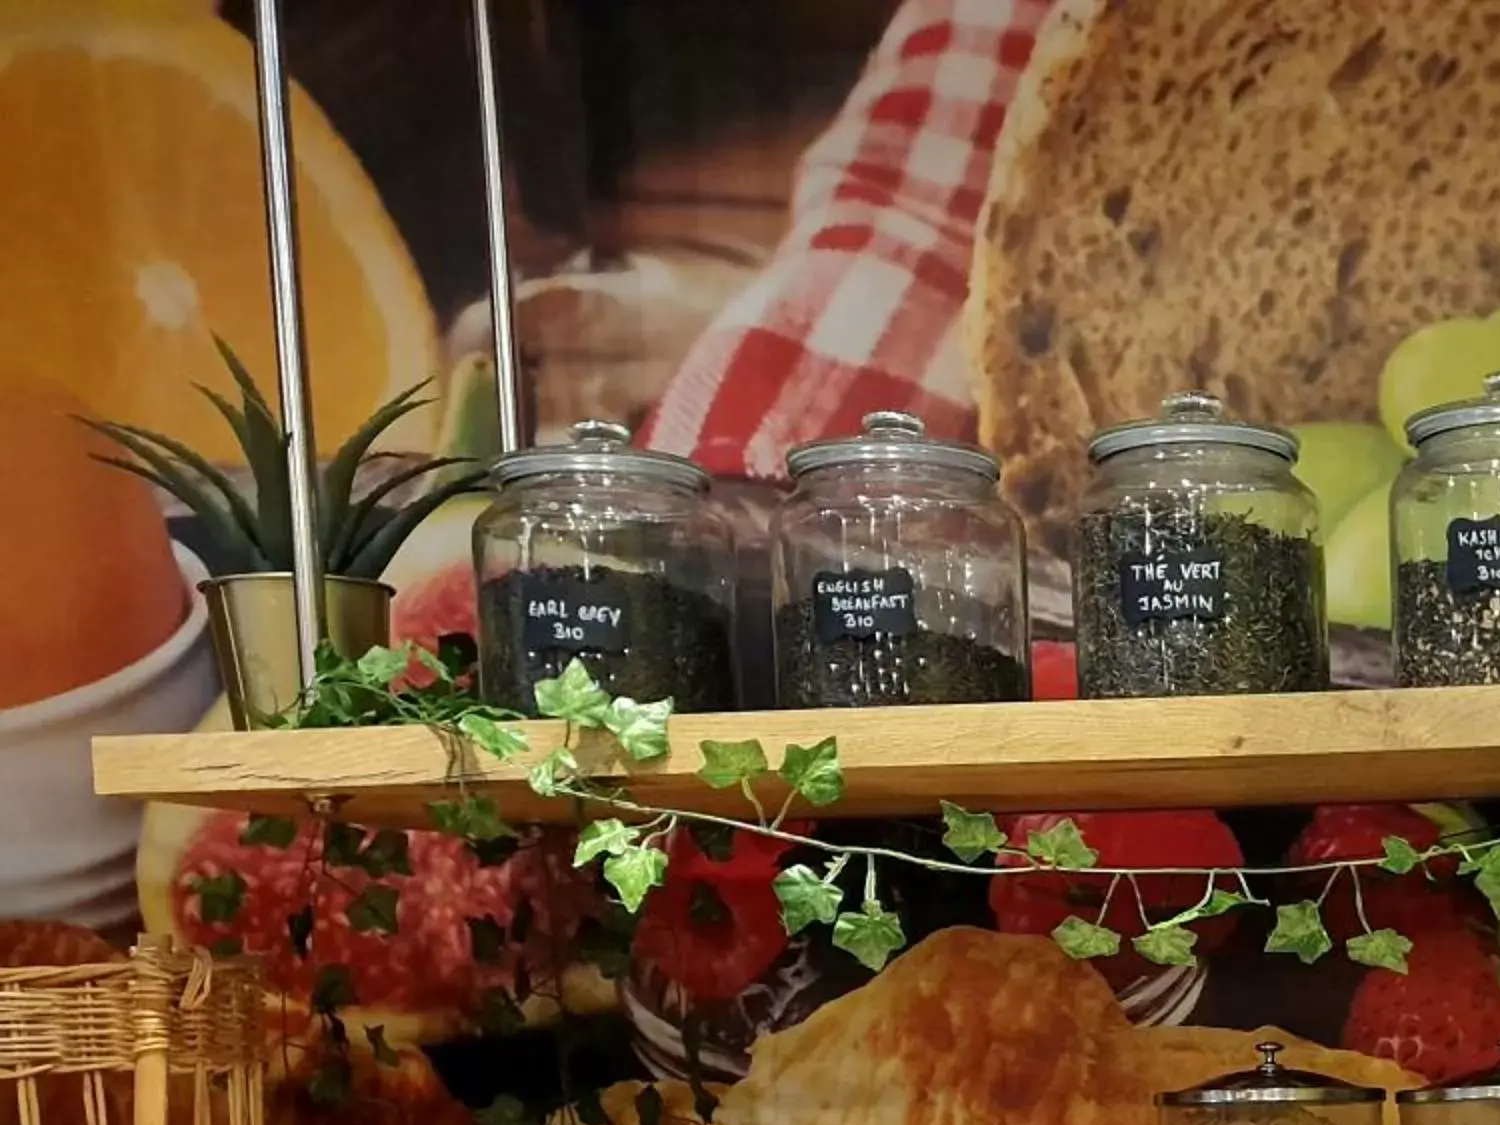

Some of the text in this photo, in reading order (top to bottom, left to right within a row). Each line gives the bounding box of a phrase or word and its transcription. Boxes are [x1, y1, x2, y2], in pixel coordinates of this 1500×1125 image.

[1130, 554, 1220, 581] THÉ VERT
[817, 577, 884, 594] ENGLISH
[1163, 579, 1183, 592] AU
[528, 600, 568, 618] EARL
[831, 594, 909, 612] BREAKFAST
[1137, 594, 1213, 612] JASMIN
